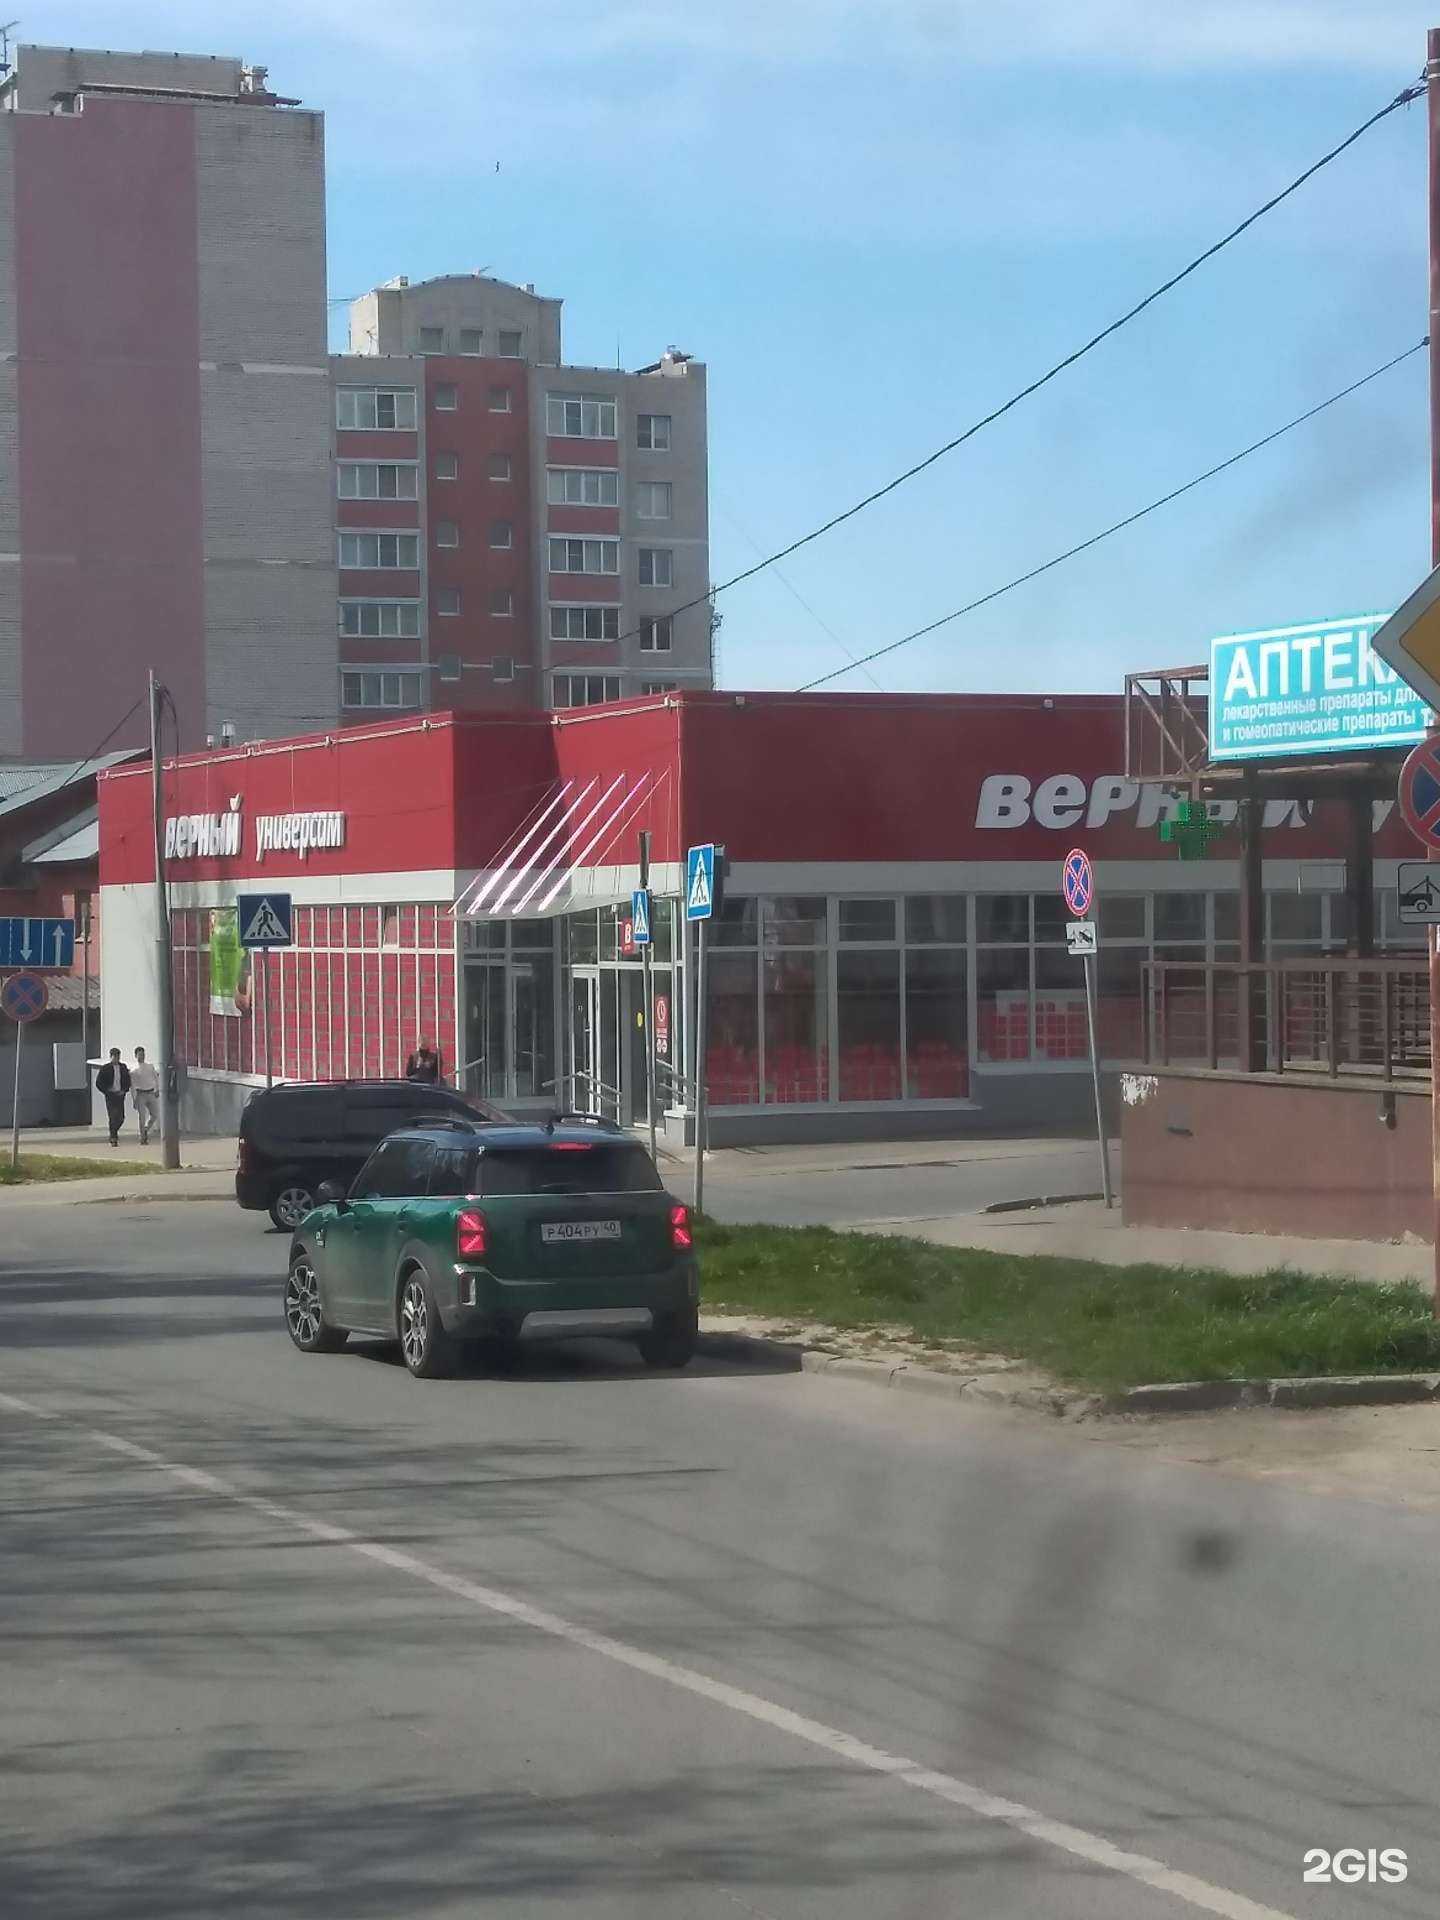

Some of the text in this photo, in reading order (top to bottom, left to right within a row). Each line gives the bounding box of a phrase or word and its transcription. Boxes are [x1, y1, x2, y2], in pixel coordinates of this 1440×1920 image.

[1223, 631, 1397, 701] АПТЕК
[1222, 709, 1416, 742] и гомеопатические препараты
[1223, 697, 1316, 721] лекарственные
[1320, 689, 1392, 715] препараты
[256, 811, 345, 861] универсам
